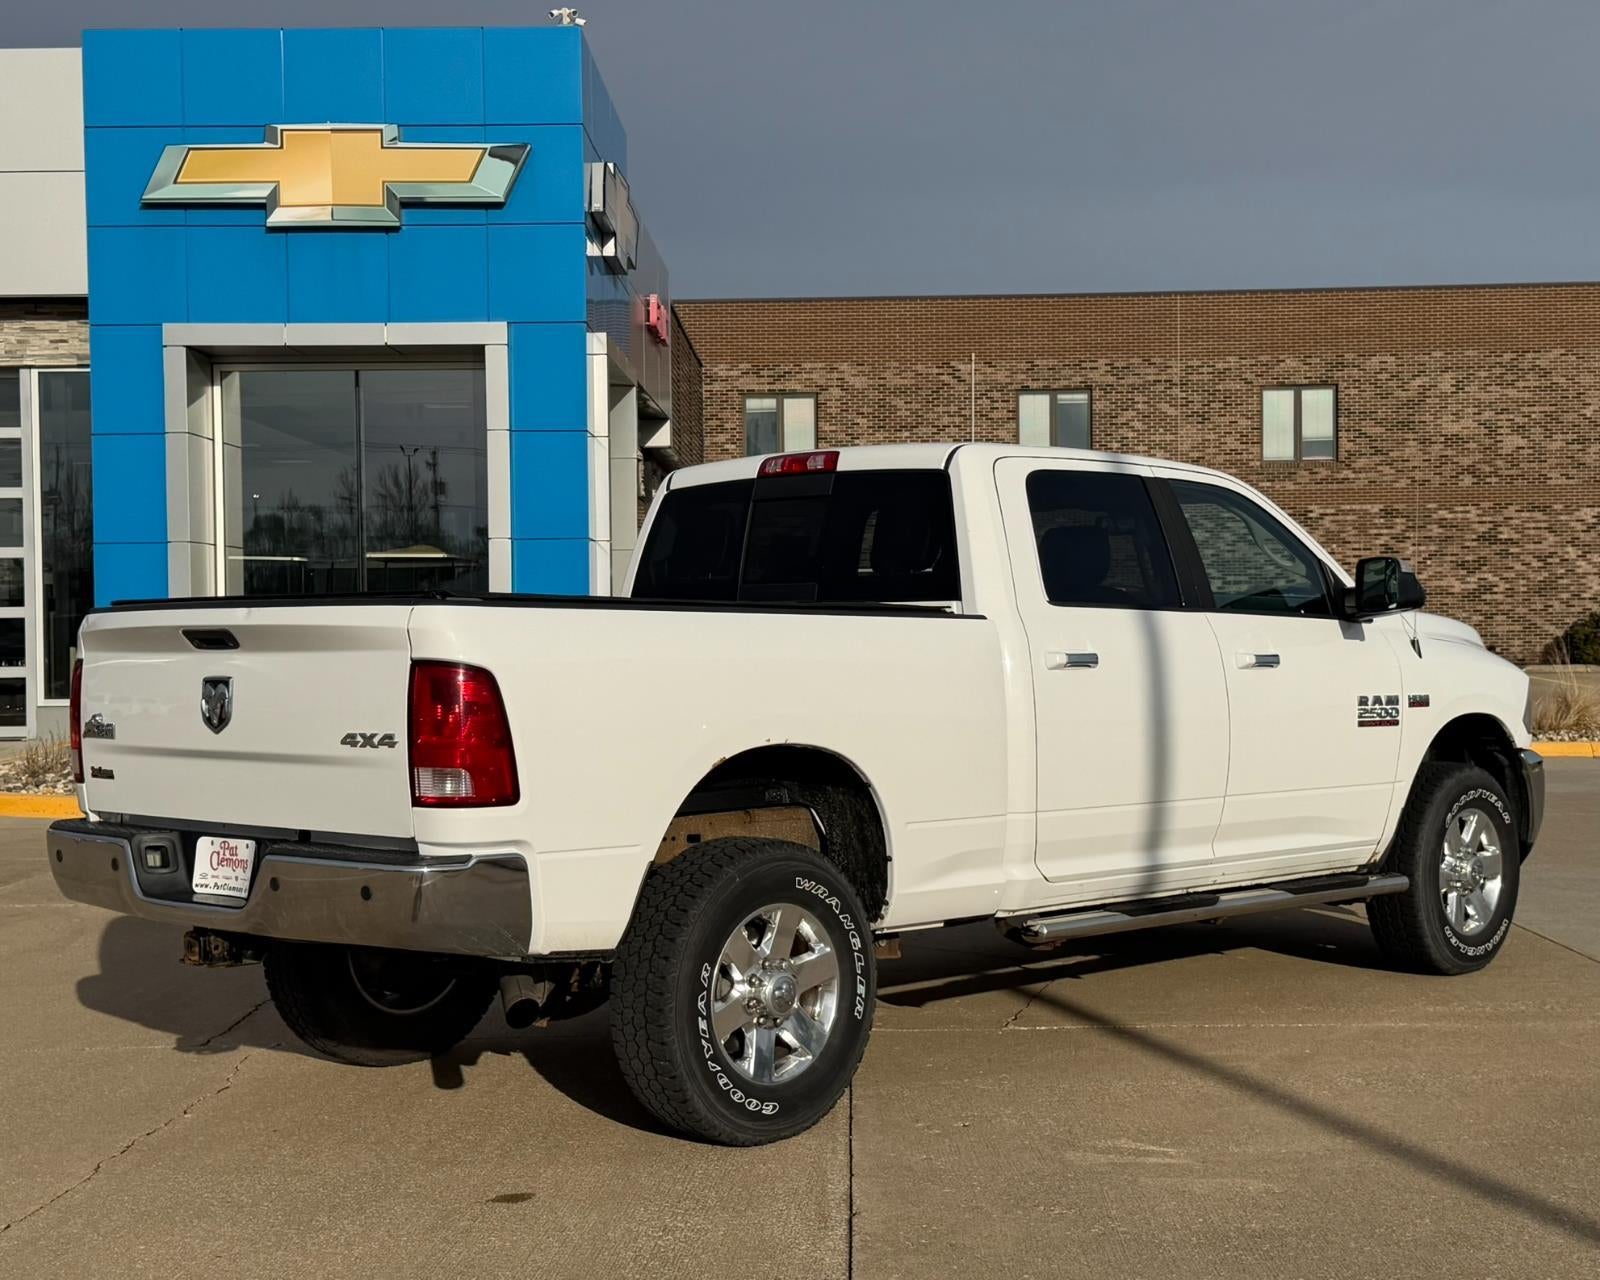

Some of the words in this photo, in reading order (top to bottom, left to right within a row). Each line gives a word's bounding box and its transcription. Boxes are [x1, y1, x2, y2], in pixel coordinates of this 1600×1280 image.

[1357, 695, 1399, 706] RAM
[1357, 707, 1399, 719] 2500
[1445, 788, 1511, 828] GOODYEAR
[219, 840, 238, 857] Pat
[209, 851, 248, 873] Clemons
[796, 877, 866, 1019] WRANGLER
[698, 963, 779, 1115] GOODYEAR
